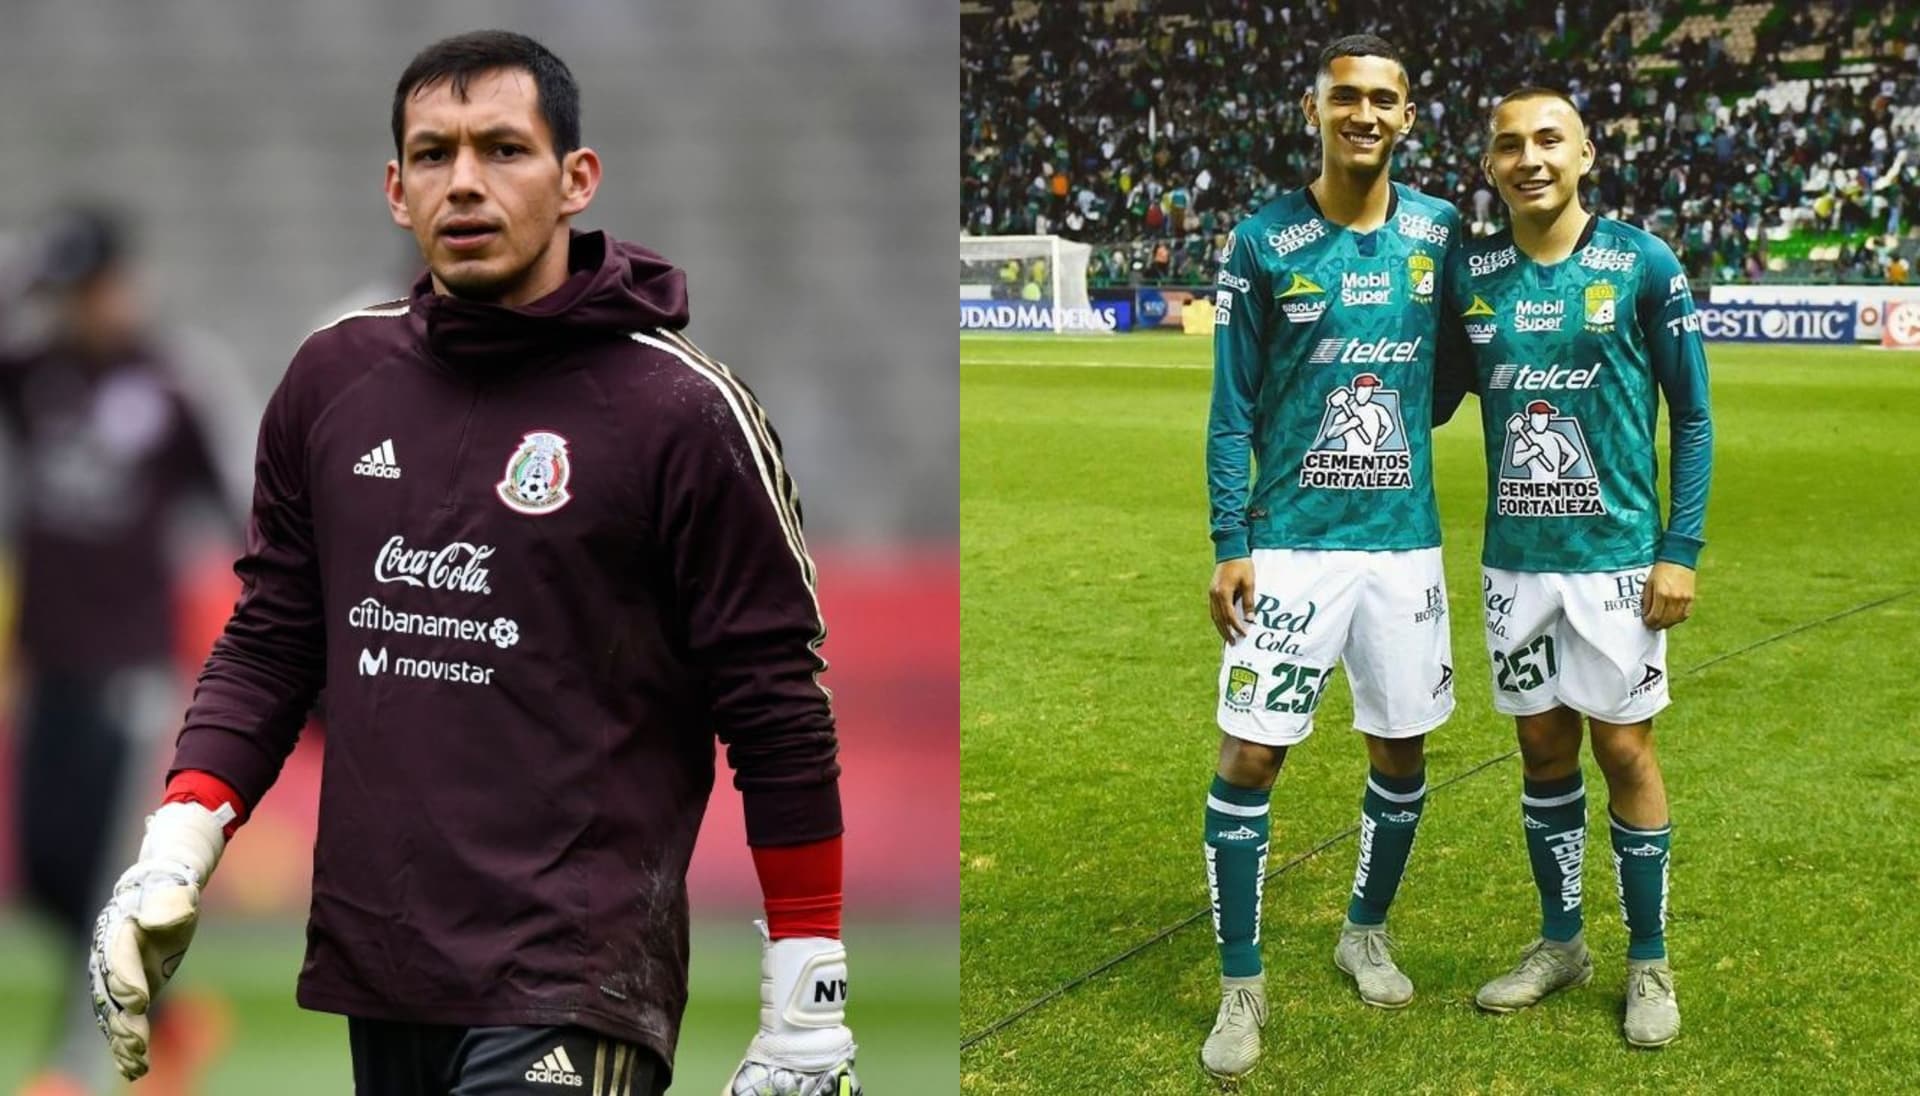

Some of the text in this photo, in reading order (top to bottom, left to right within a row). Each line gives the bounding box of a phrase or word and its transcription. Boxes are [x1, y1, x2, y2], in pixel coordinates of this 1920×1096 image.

[1269, 218, 1321, 247] Office
[1398, 224, 1447, 246] DEPOT
[1399, 213, 1449, 238] Office
[1275, 226, 1326, 258] DEPOT
[1469, 245, 1517, 267] Office
[1579, 257, 1634, 273] DEPOT
[1582, 246, 1636, 264] Office
[1470, 256, 1517, 277] DEPOT
[1342, 271, 1390, 288] Mobil
[1341, 287, 1391, 304] Super
[1515, 300, 1564, 315] Mobil
[1514, 315, 1563, 332] Super
[1341, 336, 1422, 364] telcel
[1514, 363, 1602, 390] telcel
[353, 461, 401, 480] adidas
[1305, 454, 1409, 471] CEMENTOS
[1301, 471, 1411, 488] FORTALEZA
[1500, 482, 1599, 498] CEMENTOS
[1499, 499, 1604, 515] FORTALEZA
[374, 535, 496, 593] Coca-Cola
[1614, 573, 1646, 598] HS
[349, 597, 488, 642] citibanamex
[1246, 594, 1316, 635] Red
[1255, 632, 1303, 656] Cola
[395, 656, 494, 685] movistar
[1494, 635, 1556, 693] 257
[1545, 826, 1584, 912] PERDURA
[525, 1067, 583, 1087] adidas
